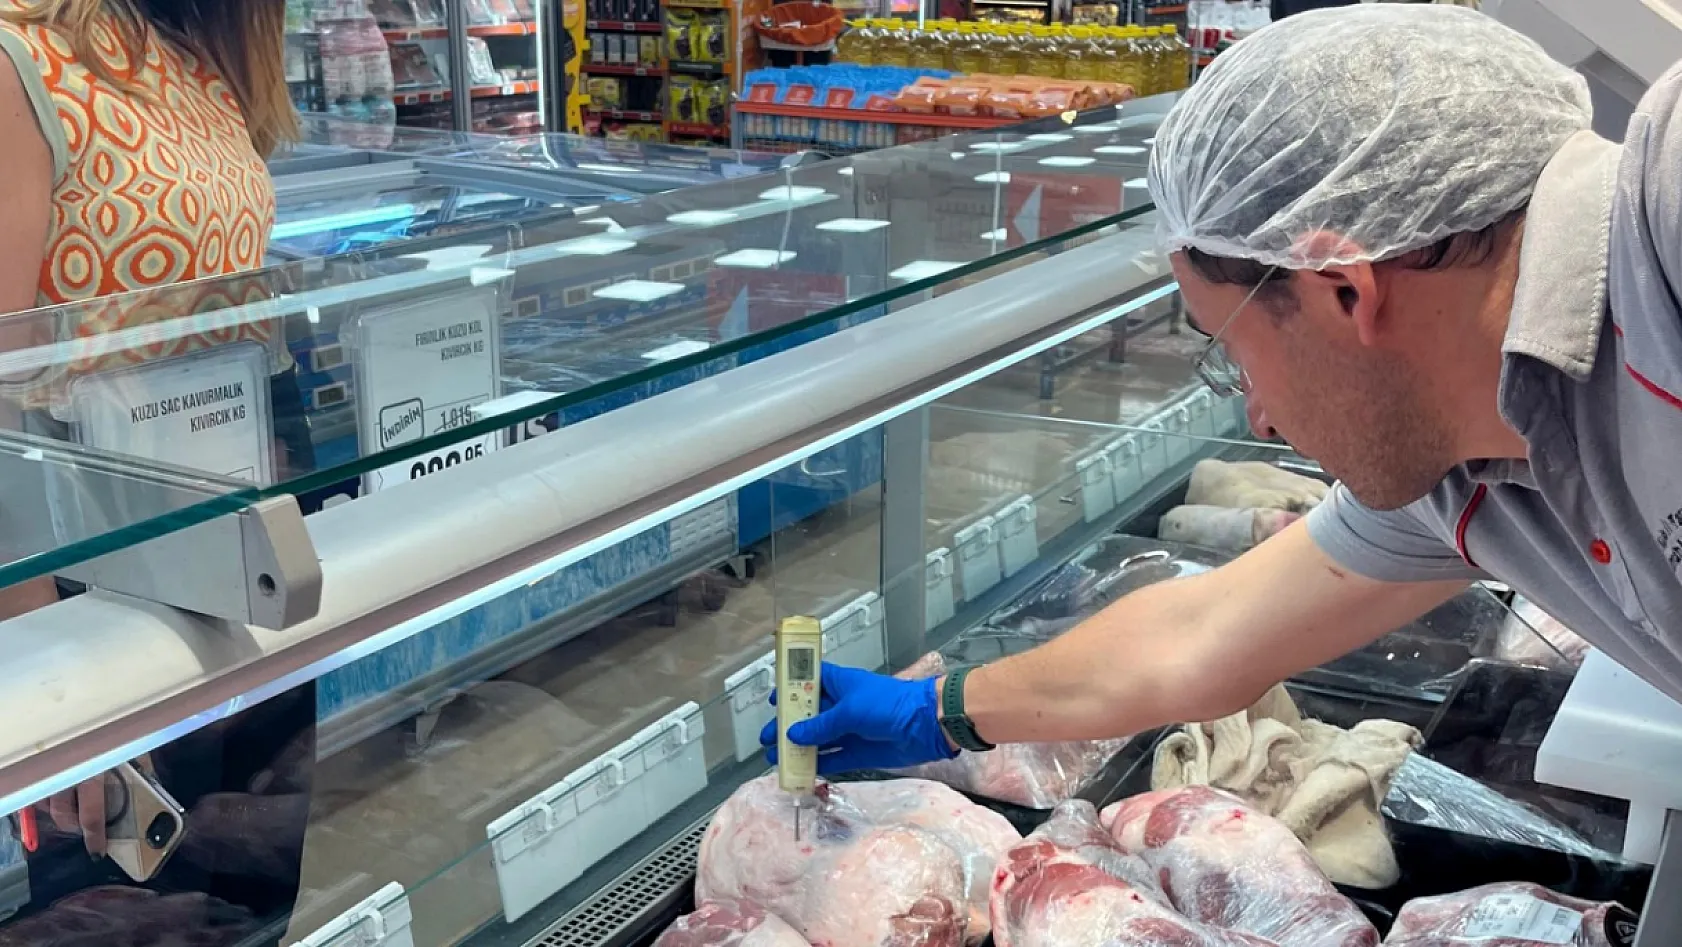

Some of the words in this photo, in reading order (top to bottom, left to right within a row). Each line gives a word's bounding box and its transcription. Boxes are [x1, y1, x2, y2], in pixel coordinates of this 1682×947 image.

[448, 323, 467, 338] KUZU
[473, 340, 484, 352] KG
[131, 402, 159, 423] KUZU
[160, 397, 181, 416] SAC
[182, 382, 244, 410] KAVURMALIK
[190, 409, 232, 432] KIVIRCIK
[233, 404, 245, 421] KG
[383, 406, 421, 443] İNDİRİM
